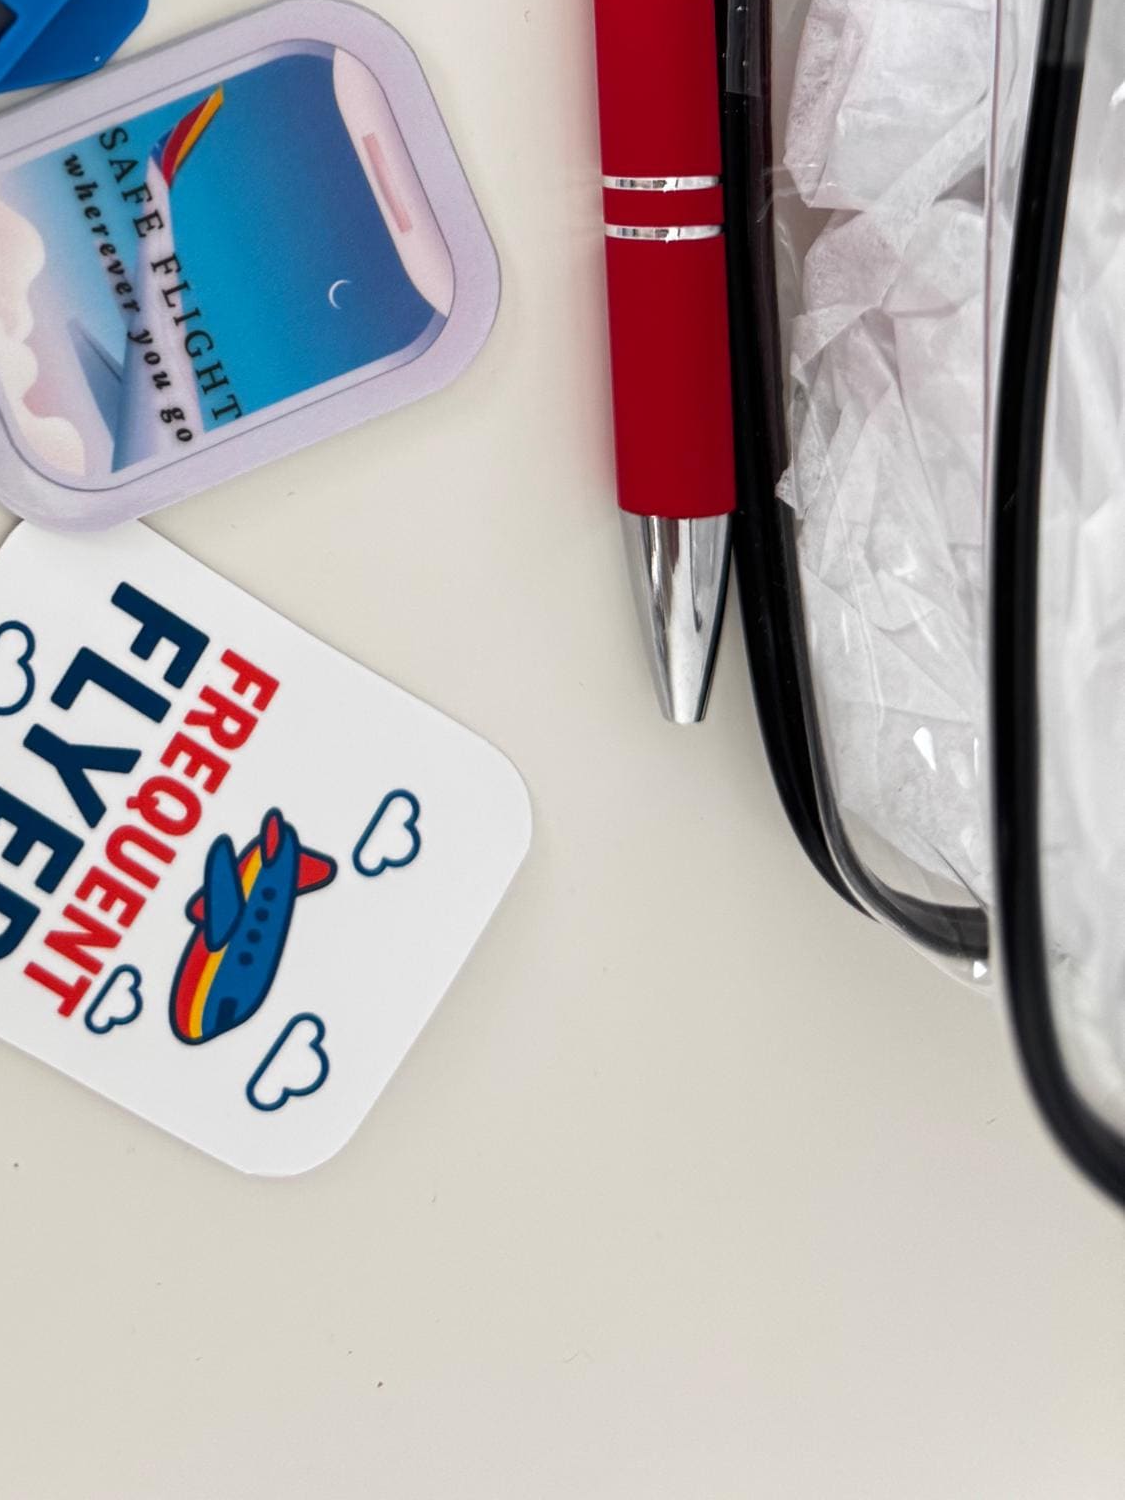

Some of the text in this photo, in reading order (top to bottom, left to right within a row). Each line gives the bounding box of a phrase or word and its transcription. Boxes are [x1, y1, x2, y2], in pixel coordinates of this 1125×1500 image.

[63, 153, 194, 443] wherever you go
[98, 126, 243, 421] SAFE FLIGHT
[23, 648, 281, 1019] FREQUENT
